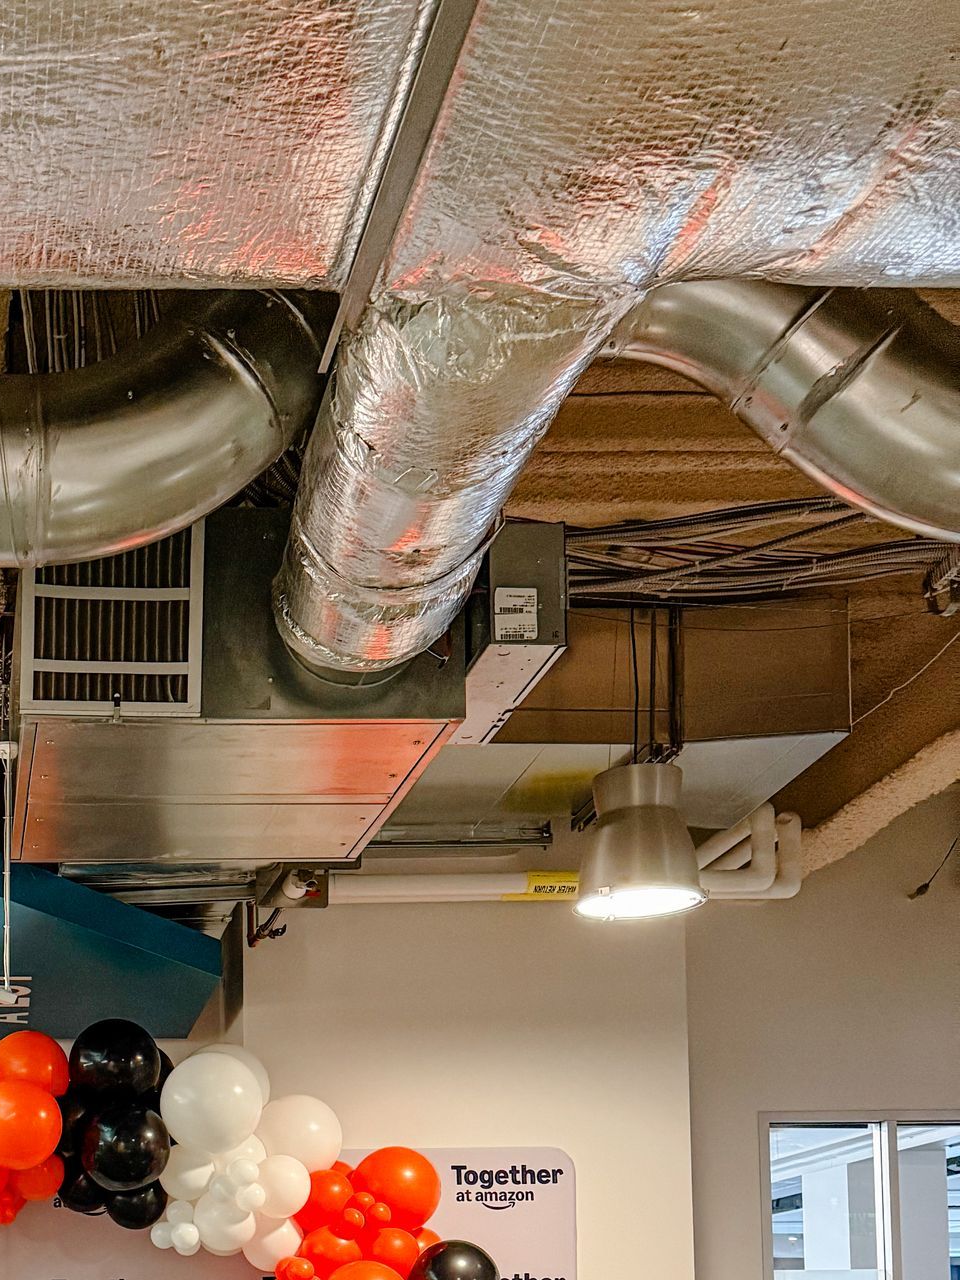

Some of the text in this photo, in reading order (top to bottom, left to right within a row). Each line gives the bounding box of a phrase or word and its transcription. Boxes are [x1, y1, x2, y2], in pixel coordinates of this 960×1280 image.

[533, 885, 556, 894] RETURN
[451, 1165, 563, 1189] Together
[456, 1190, 534, 1202] at amazon
